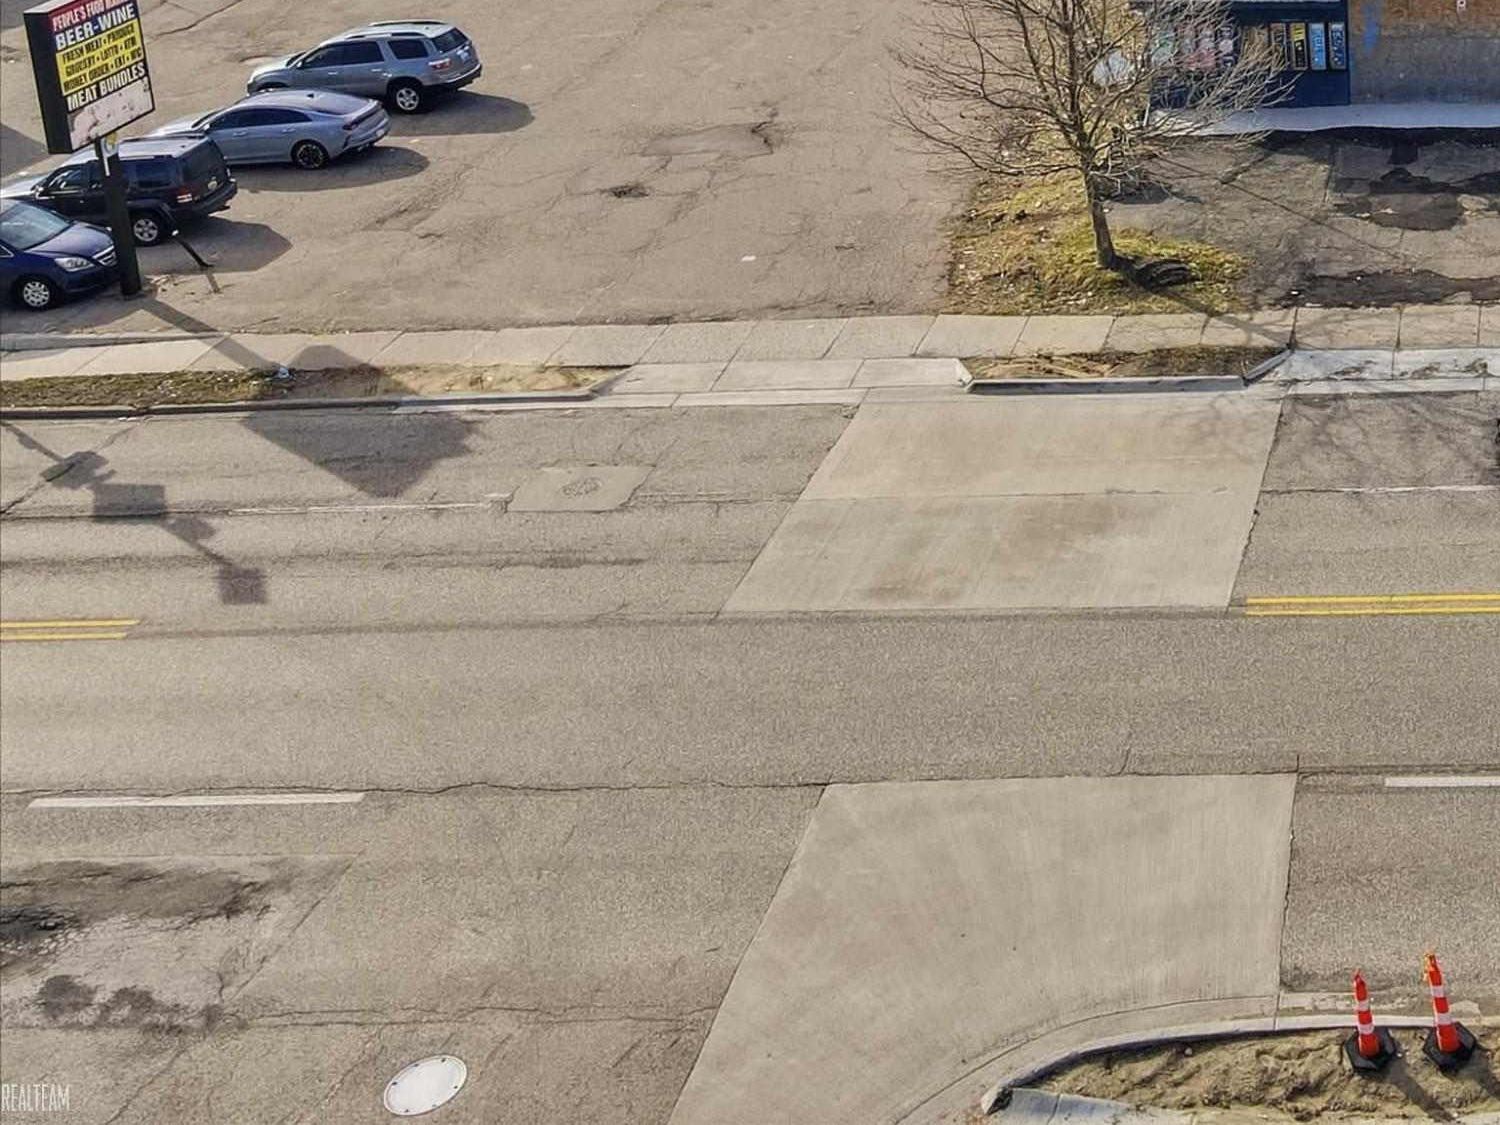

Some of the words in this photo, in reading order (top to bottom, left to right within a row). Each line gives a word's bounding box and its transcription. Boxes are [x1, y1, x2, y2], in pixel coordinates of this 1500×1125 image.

[52, 5, 86, 32] PEOPLE'S
[55, 4, 135, 50] BEER-WINE
[62, 47, 84, 64] FRESH
[85, 38, 103, 54] MEAT
[107, 23, 135, 43] PRODUCE
[100, 45, 119, 60] LOTTO
[63, 73, 87, 93] MONEY
[89, 63, 111, 82] ORDER
[130, 48, 142, 61] WIC
[66, 84, 98, 111] MEAT
[99, 62, 146, 96] BUNDLES
